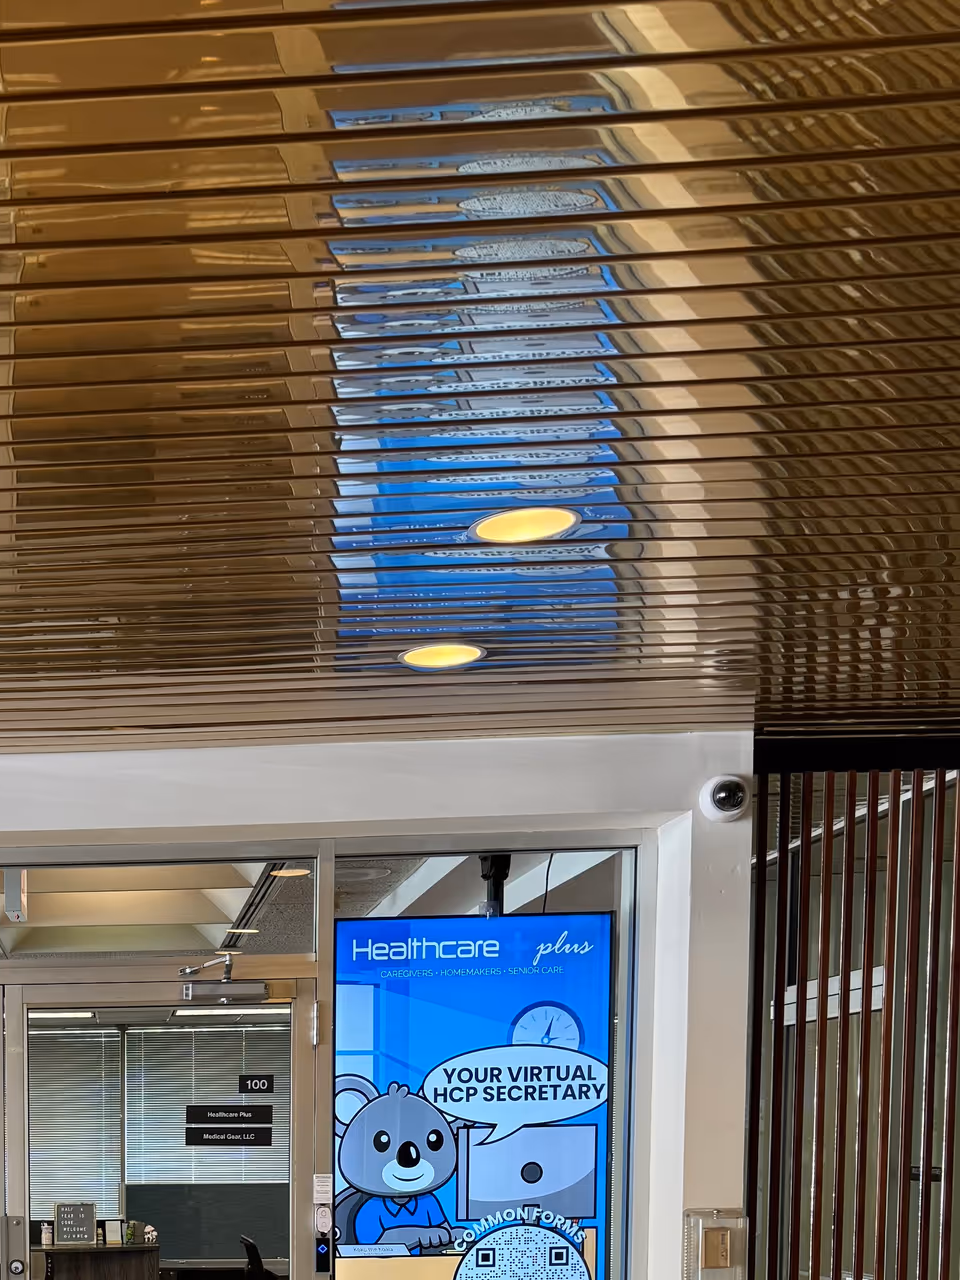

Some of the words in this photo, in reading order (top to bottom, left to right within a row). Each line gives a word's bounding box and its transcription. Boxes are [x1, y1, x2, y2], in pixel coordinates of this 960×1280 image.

[352, 937, 500, 961] Healthcare
[532, 930, 594, 966] plus
[380, 969, 434, 979] CAREGIVERS
[440, 968, 502, 977] HOMEMAKERS
[508, 966, 540, 975] SENIOR
[541, 966, 565, 975] CARE
[246, 1079, 268, 1090] 100
[443, 1066, 502, 1084] YOUR
[507, 1065, 597, 1083] VIRTUAL
[433, 1085, 478, 1104] HCP
[482, 1083, 606, 1103] SECRETARY
[453, 1206, 529, 1252] COMMON
[531, 1207, 587, 1244] FORMS
